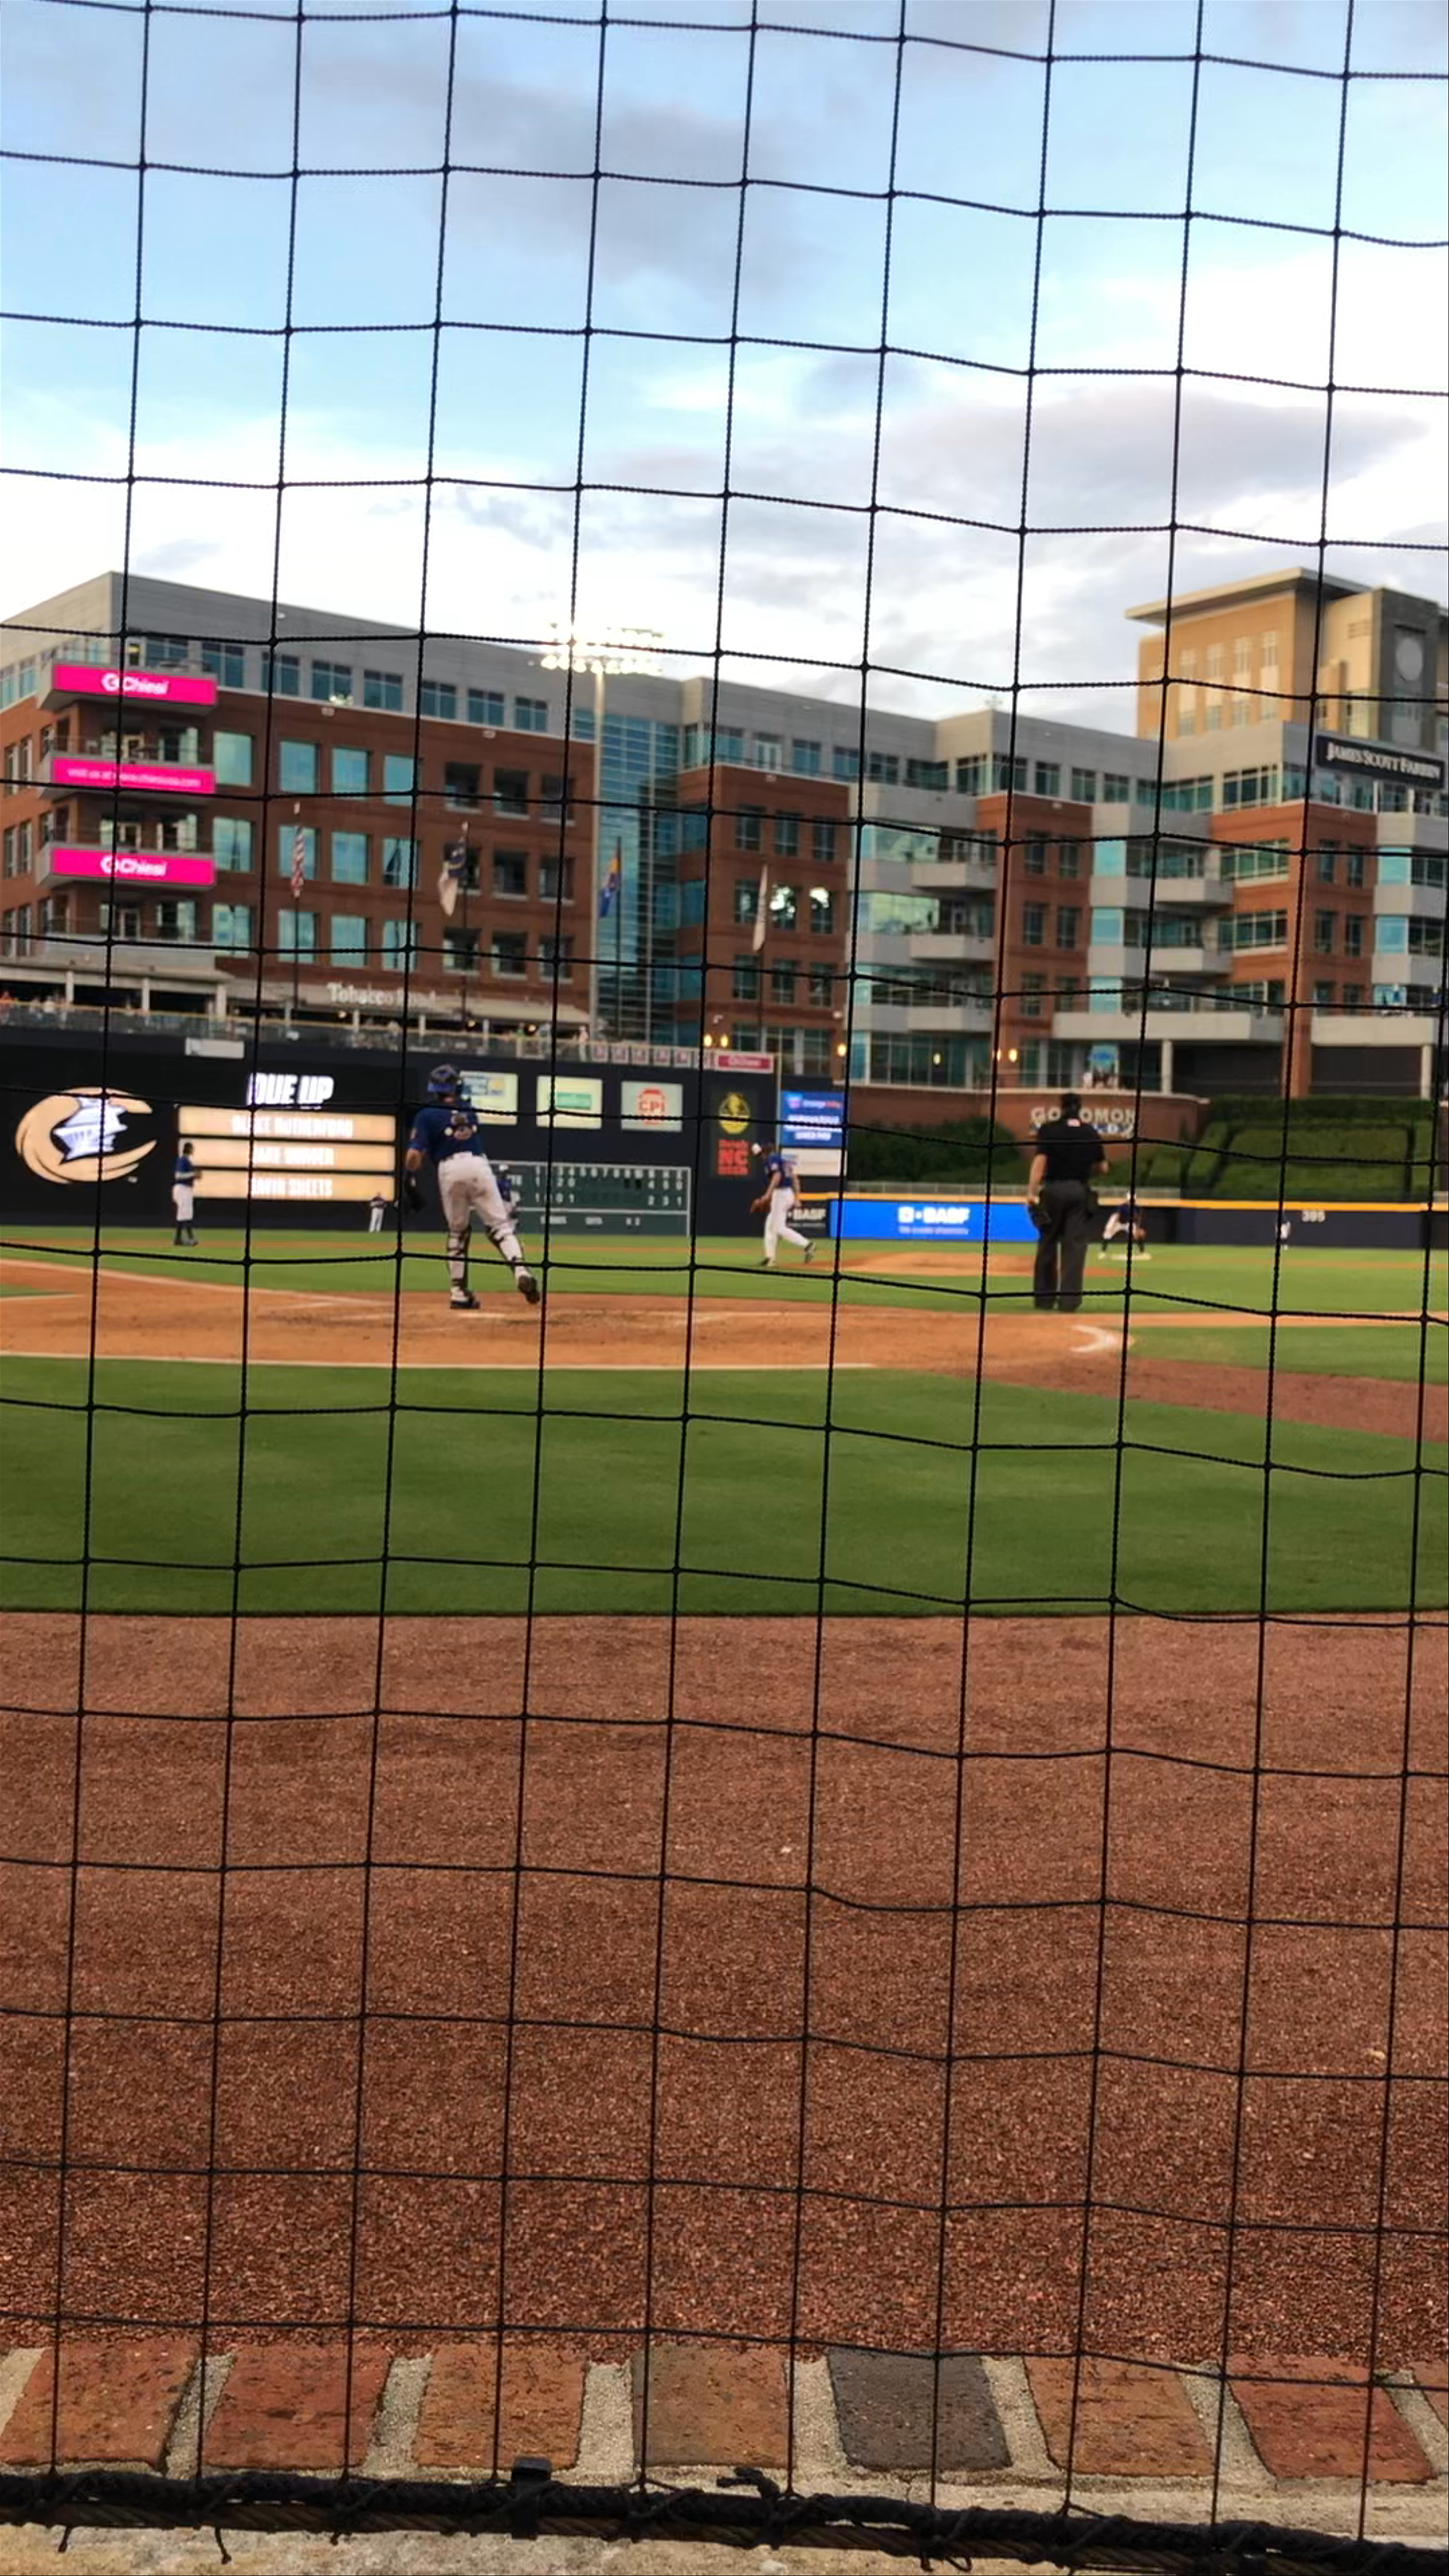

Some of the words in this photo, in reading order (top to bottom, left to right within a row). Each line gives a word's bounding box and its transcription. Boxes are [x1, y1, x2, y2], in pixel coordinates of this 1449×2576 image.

[326, 981, 395, 1006] Tobacco
[247, 1073, 298, 1108] DUE
[297, 1076, 334, 1109] UP
[638, 1101, 665, 1113] CPI
[718, 1150, 749, 1165] NC
[648, 1180, 655, 1189] 4
[793, 1209, 826, 1220] BASF
[923, 1207, 970, 1224] BASF
